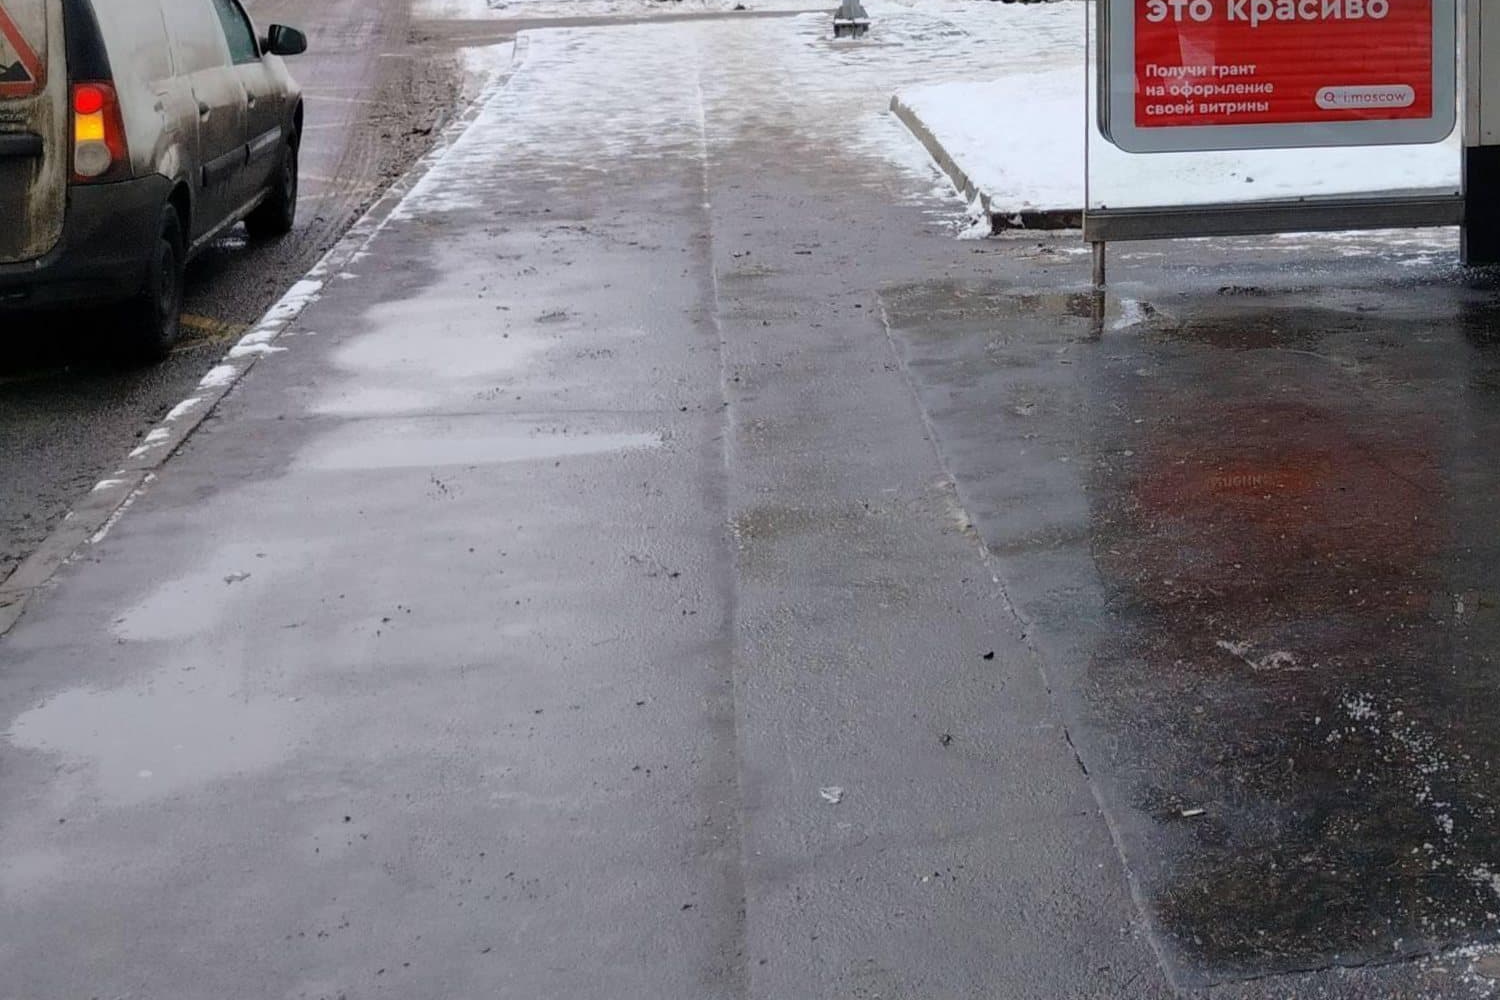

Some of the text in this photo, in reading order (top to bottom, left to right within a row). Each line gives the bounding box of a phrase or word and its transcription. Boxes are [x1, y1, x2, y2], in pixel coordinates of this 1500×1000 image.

[1145, 64, 1257, 79] Получи грант
[1145, 81, 1274, 98] на оформление
[1145, 100, 1269, 116] своей витрины
